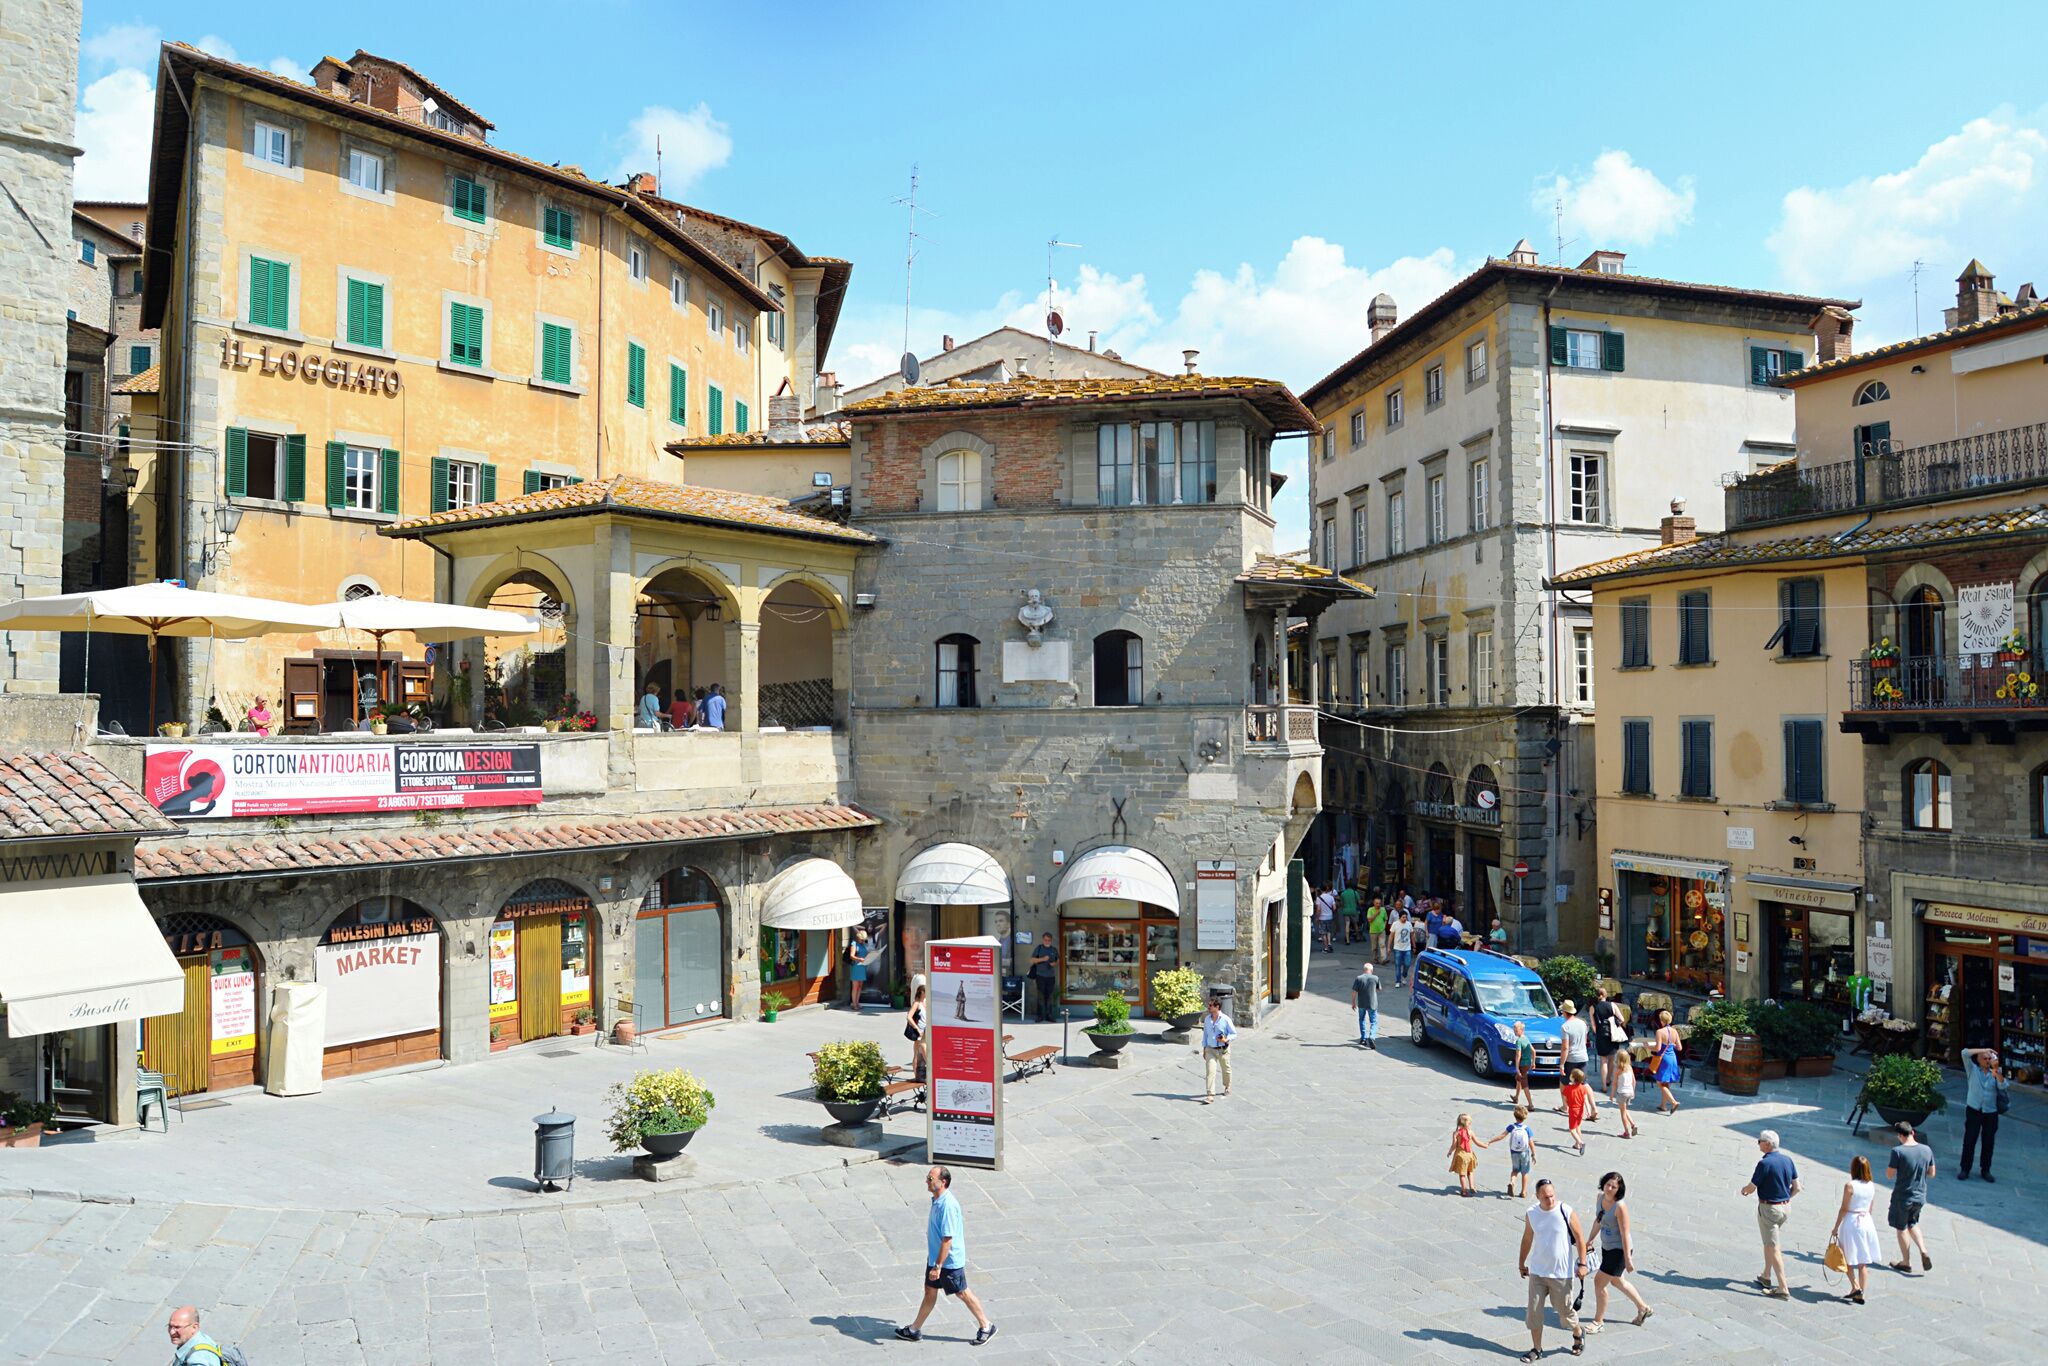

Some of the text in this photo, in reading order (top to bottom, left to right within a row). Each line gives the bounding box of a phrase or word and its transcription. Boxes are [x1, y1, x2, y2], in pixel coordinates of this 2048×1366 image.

[222, 337, 403, 395] IL LOGGIATO
[1960, 588, 2012, 603] Real Estate
[1963, 634, 2003, 650] Toscan
[233, 752, 392, 775] CORTONANTIQUARIA
[400, 776, 424, 787] ETTORE
[425, 775, 457, 786] SOTTSASS
[457, 775, 477, 785] PAOLO
[477, 774, 506, 784] STACCIOLI
[377, 796, 388, 808] 23
[388, 795, 417, 808] AGOSTO
[425, 794, 464, 806] SETTEMBRE
[1774, 888, 1826, 906] Wineshop
[503, 897, 592, 919] SUPERMARKET
[1934, 907, 1963, 920] Enoteca
[1966, 912, 2000, 924] Molesini
[330, 918, 434, 943] MOLESINI DAL 1937
[1868, 939, 1890, 949] Enoteca
[336, 946, 422, 977] MARKET
[214, 974, 253, 990] QUICK LUNCH
[226, 1039, 242, 1047] EXIT
